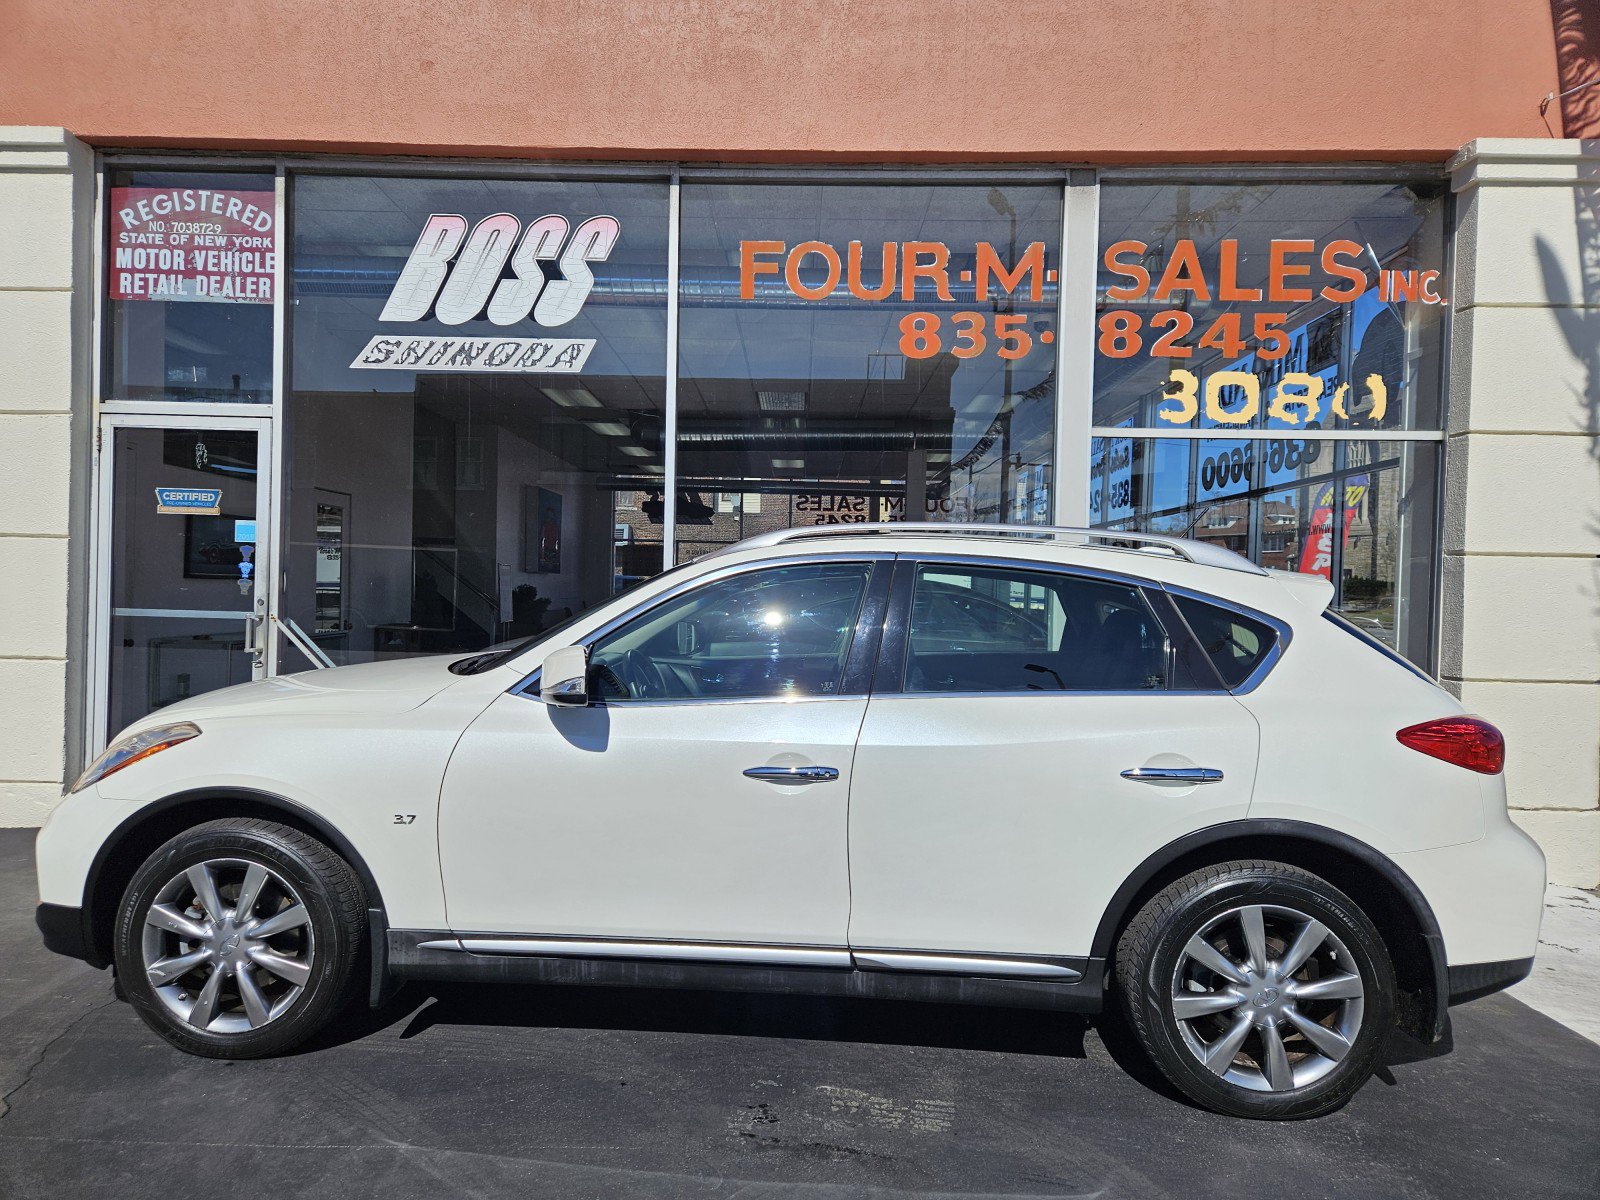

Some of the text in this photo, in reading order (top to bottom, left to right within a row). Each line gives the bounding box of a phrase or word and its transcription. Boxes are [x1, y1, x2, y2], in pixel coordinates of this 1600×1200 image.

[119, 190, 272, 232] REGISTERED
[119, 233, 273, 248] STATE OF NEW YORK
[172, 222, 221, 234] 7038729
[116, 248, 275, 273] MOTOR VEHICLE
[378, 212, 621, 327] BOSS
[1103, 239, 1368, 303] SALES
[119, 273, 271, 298] RETAIL DEALER
[1098, 309, 1292, 361] 8245
[162, 491, 215, 502] CERTIFIED
[1320, 485, 1366, 507] ATO
